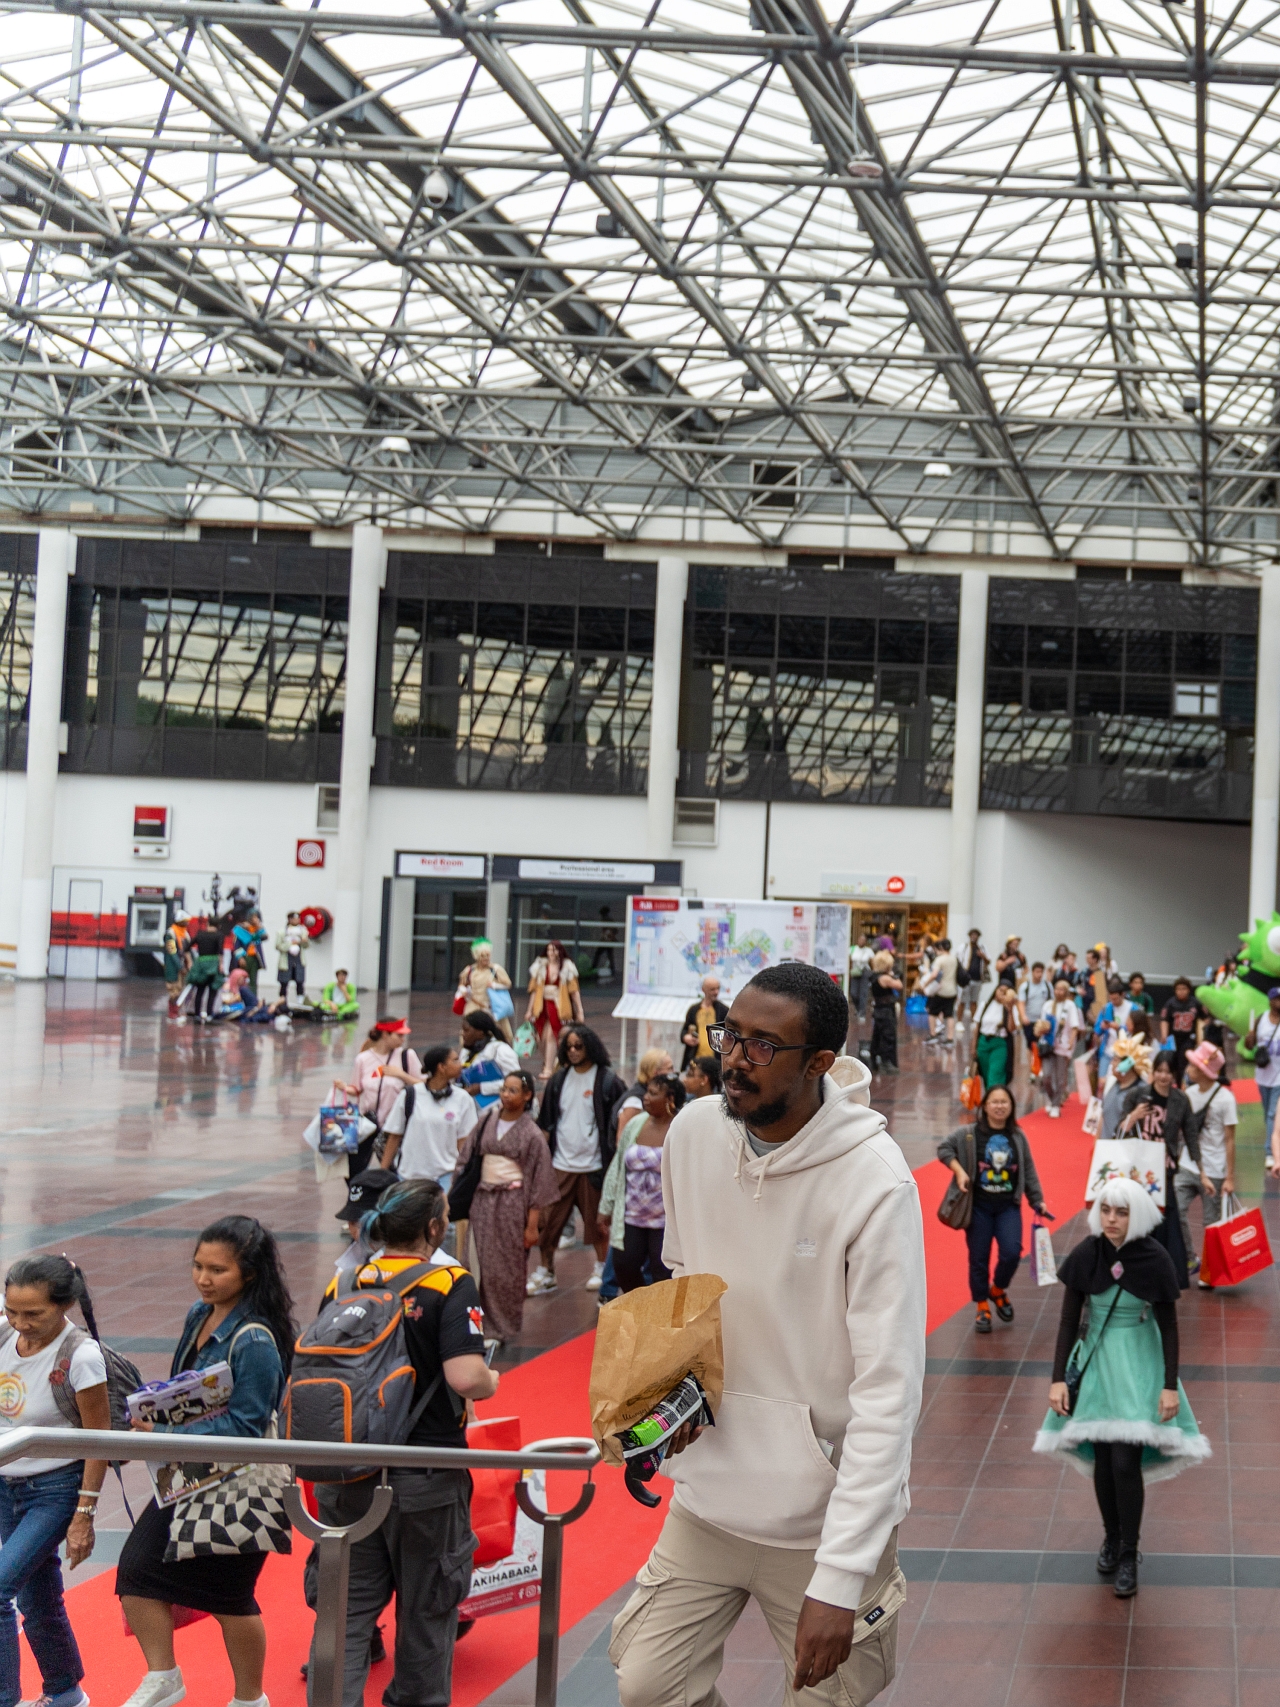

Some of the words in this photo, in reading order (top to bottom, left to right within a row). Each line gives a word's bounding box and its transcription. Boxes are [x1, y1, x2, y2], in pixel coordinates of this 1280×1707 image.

[420, 857, 437, 866] Red
[439, 858, 464, 867] Room
[473, 1564, 538, 1588] AKIHABARA
